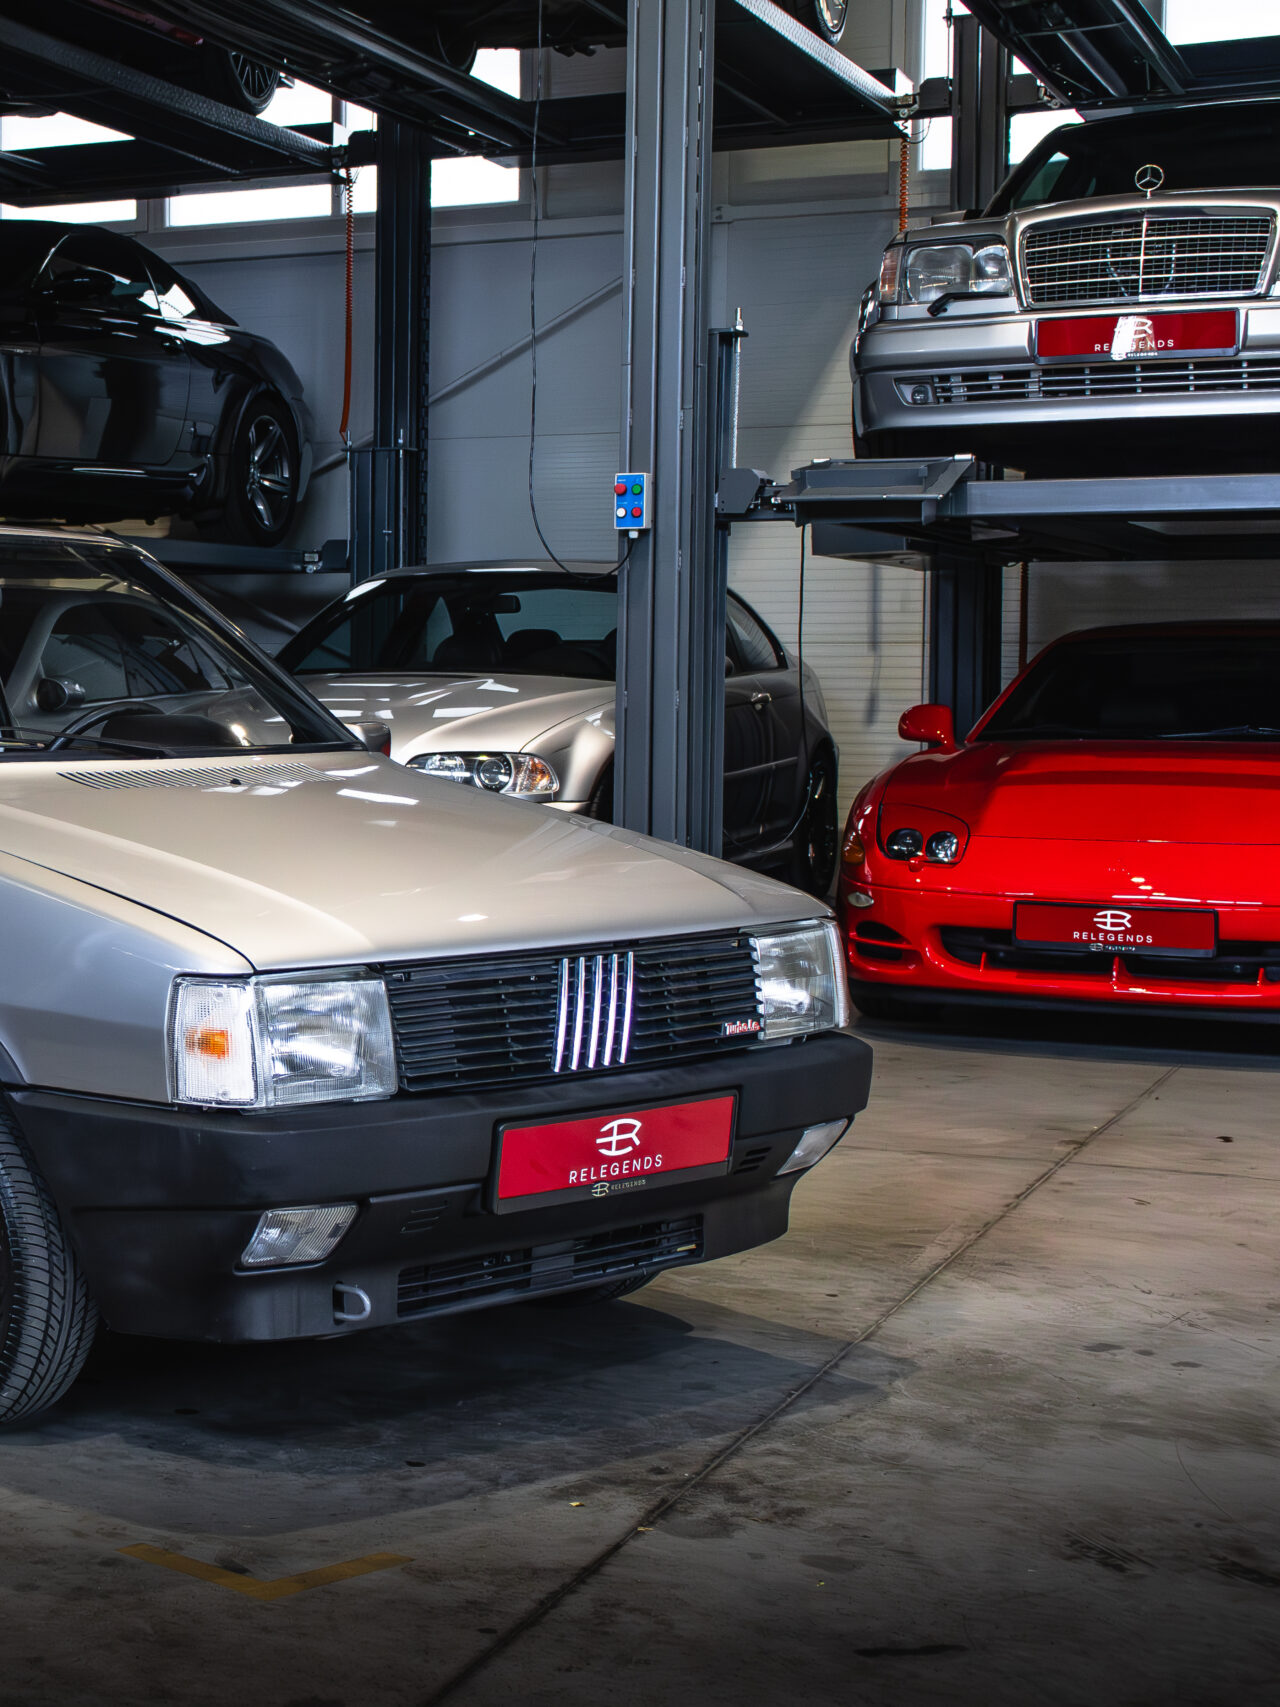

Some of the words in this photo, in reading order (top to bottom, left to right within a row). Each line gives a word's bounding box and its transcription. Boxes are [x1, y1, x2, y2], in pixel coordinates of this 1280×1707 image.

[1094, 339, 1174, 352] REGENDS
[1073, 931, 1153, 944] RELEGENDS
[725, 1020, 747, 1036] Turbo
[569, 1154, 663, 1184] RELEGENDS
